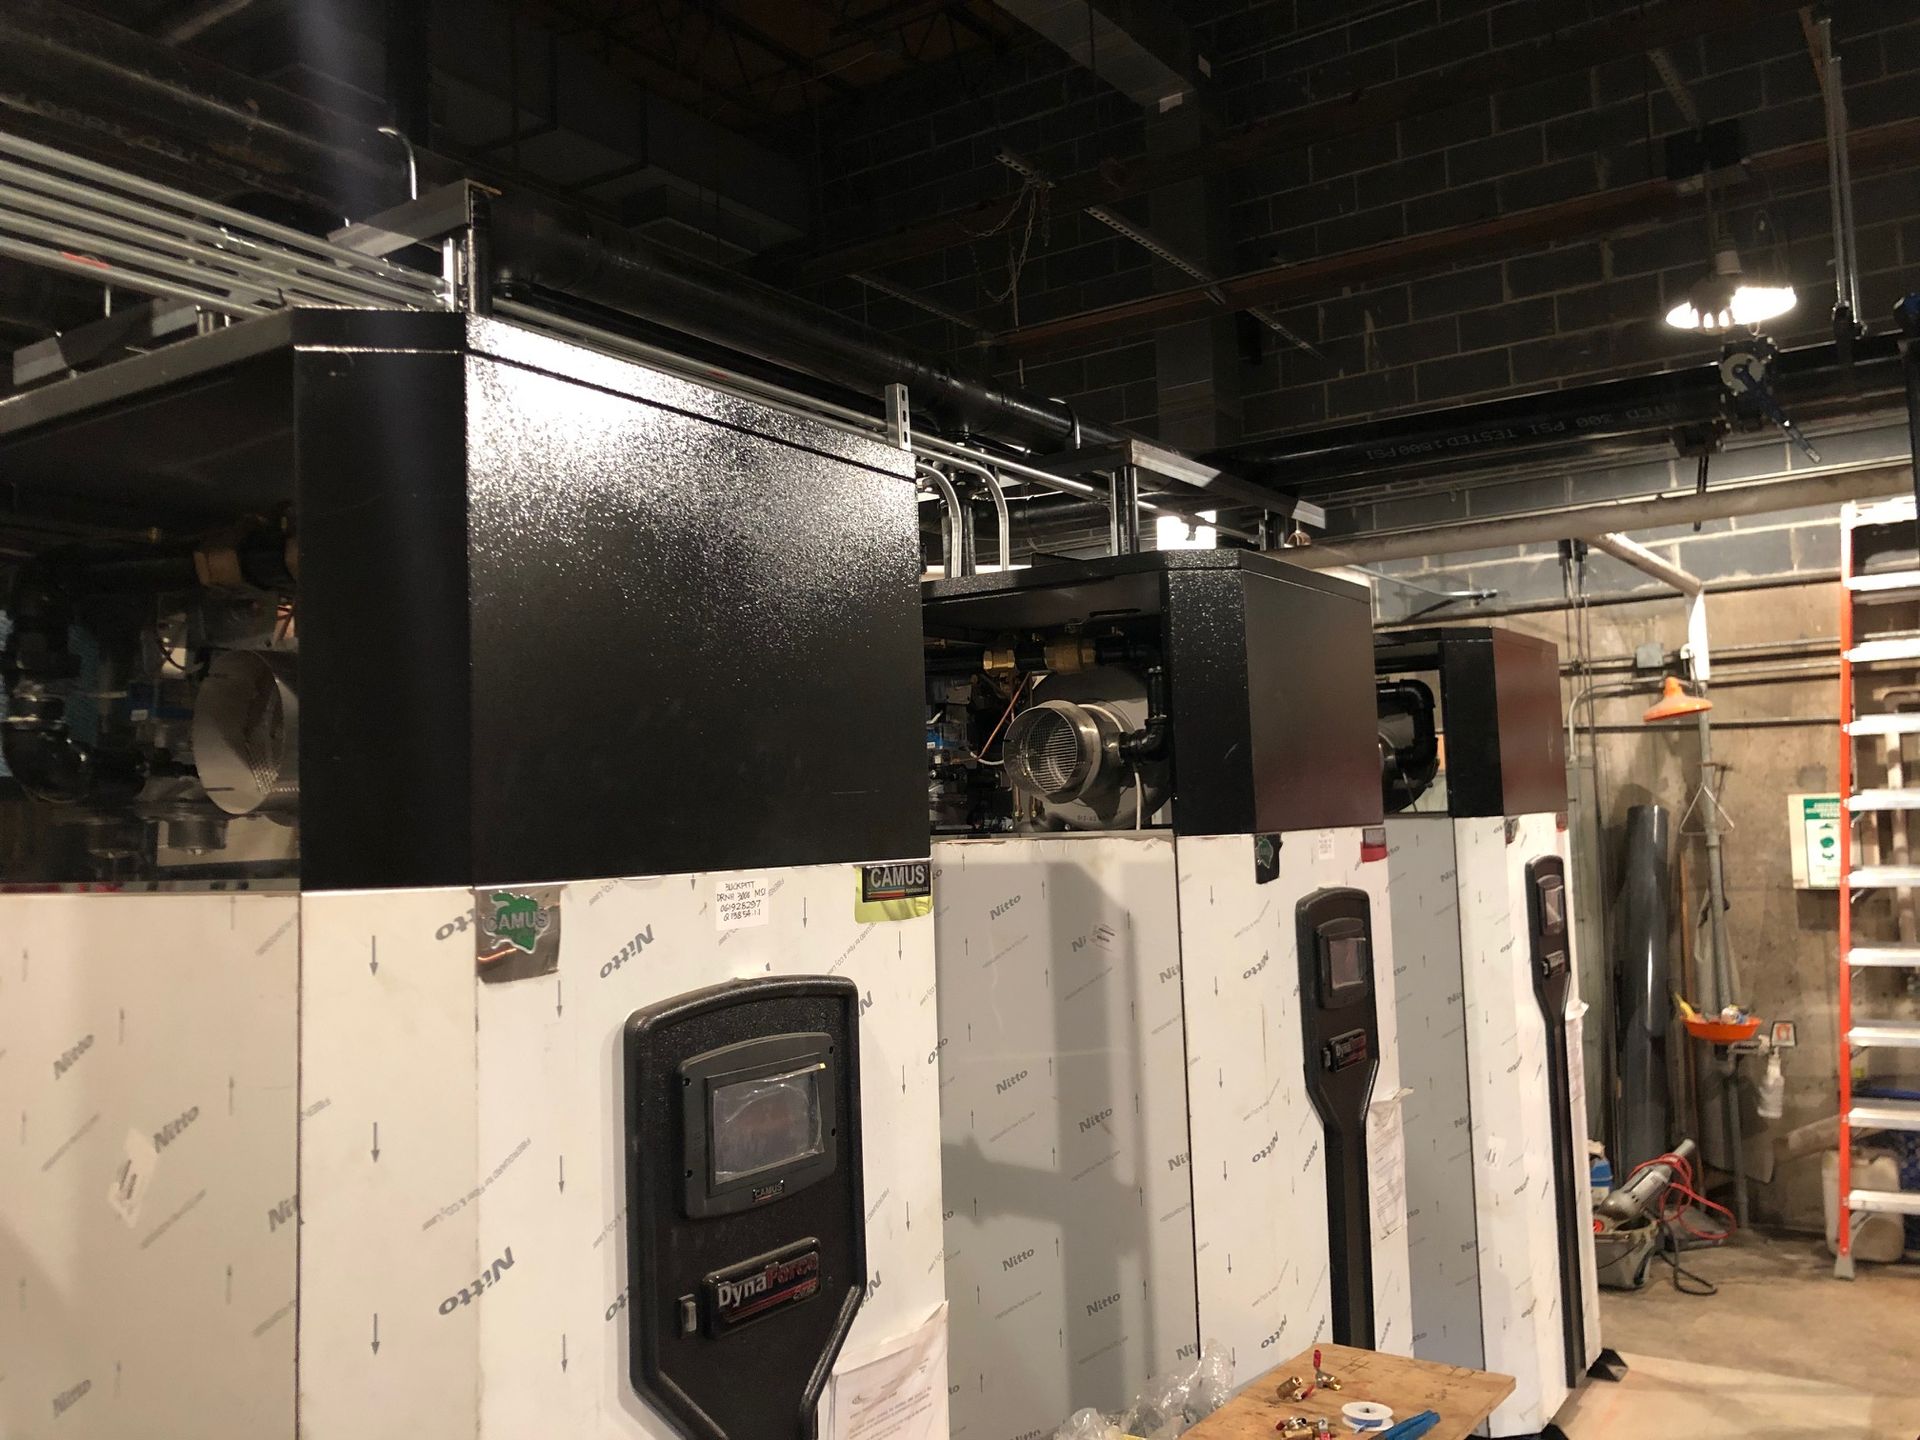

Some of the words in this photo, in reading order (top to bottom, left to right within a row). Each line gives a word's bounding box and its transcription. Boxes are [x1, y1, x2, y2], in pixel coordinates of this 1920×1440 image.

[1447, 429, 1519, 447] TESTED
[1527, 420, 1566, 434] PSI
[1365, 446, 1397, 460] PSI
[870, 864, 926, 888] CAMUS
[483, 907, 548, 931] CAMUS
[989, 894, 1022, 921] Nitto
[435, 907, 476, 941] tto
[599, 923, 655, 979] Nitto
[995, 1069, 1028, 1094] Nitto
[153, 1105, 199, 1154] Nitto
[1078, 1107, 1114, 1133] Nitto
[1002, 1248, 1034, 1271] Nitto
[438, 1246, 515, 1315] Nitto
[1086, 1292, 1121, 1316] Nitto
